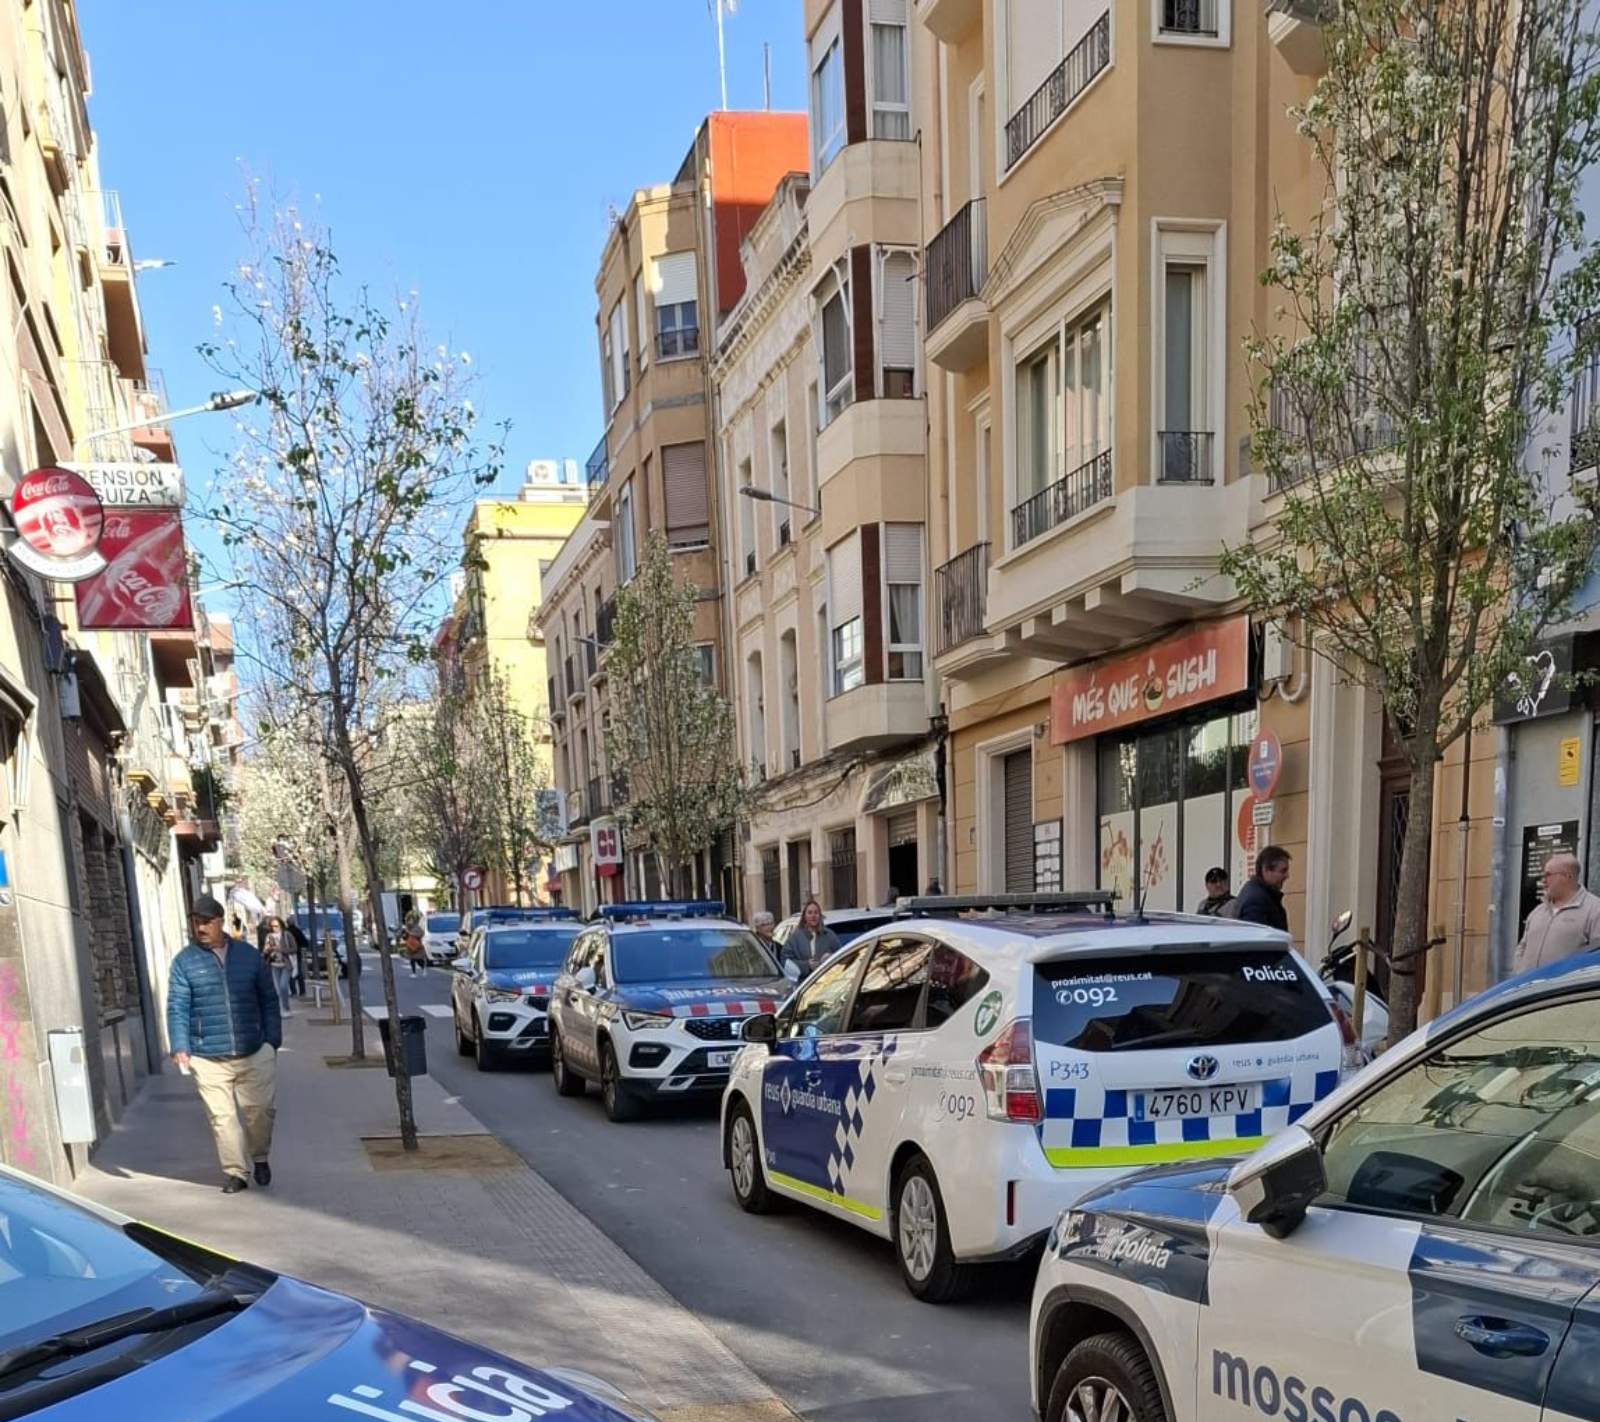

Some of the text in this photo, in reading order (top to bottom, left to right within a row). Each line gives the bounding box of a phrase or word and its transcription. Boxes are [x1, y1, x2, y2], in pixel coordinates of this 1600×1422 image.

[95, 488, 151, 503] SUIZA
[1072, 649, 1217, 726] MÉS QUE SUSHI
[1050, 1061, 1090, 1080] P343
[947, 1094, 975, 1121] 092
[1149, 1088, 1249, 1118] 4760 KPV
